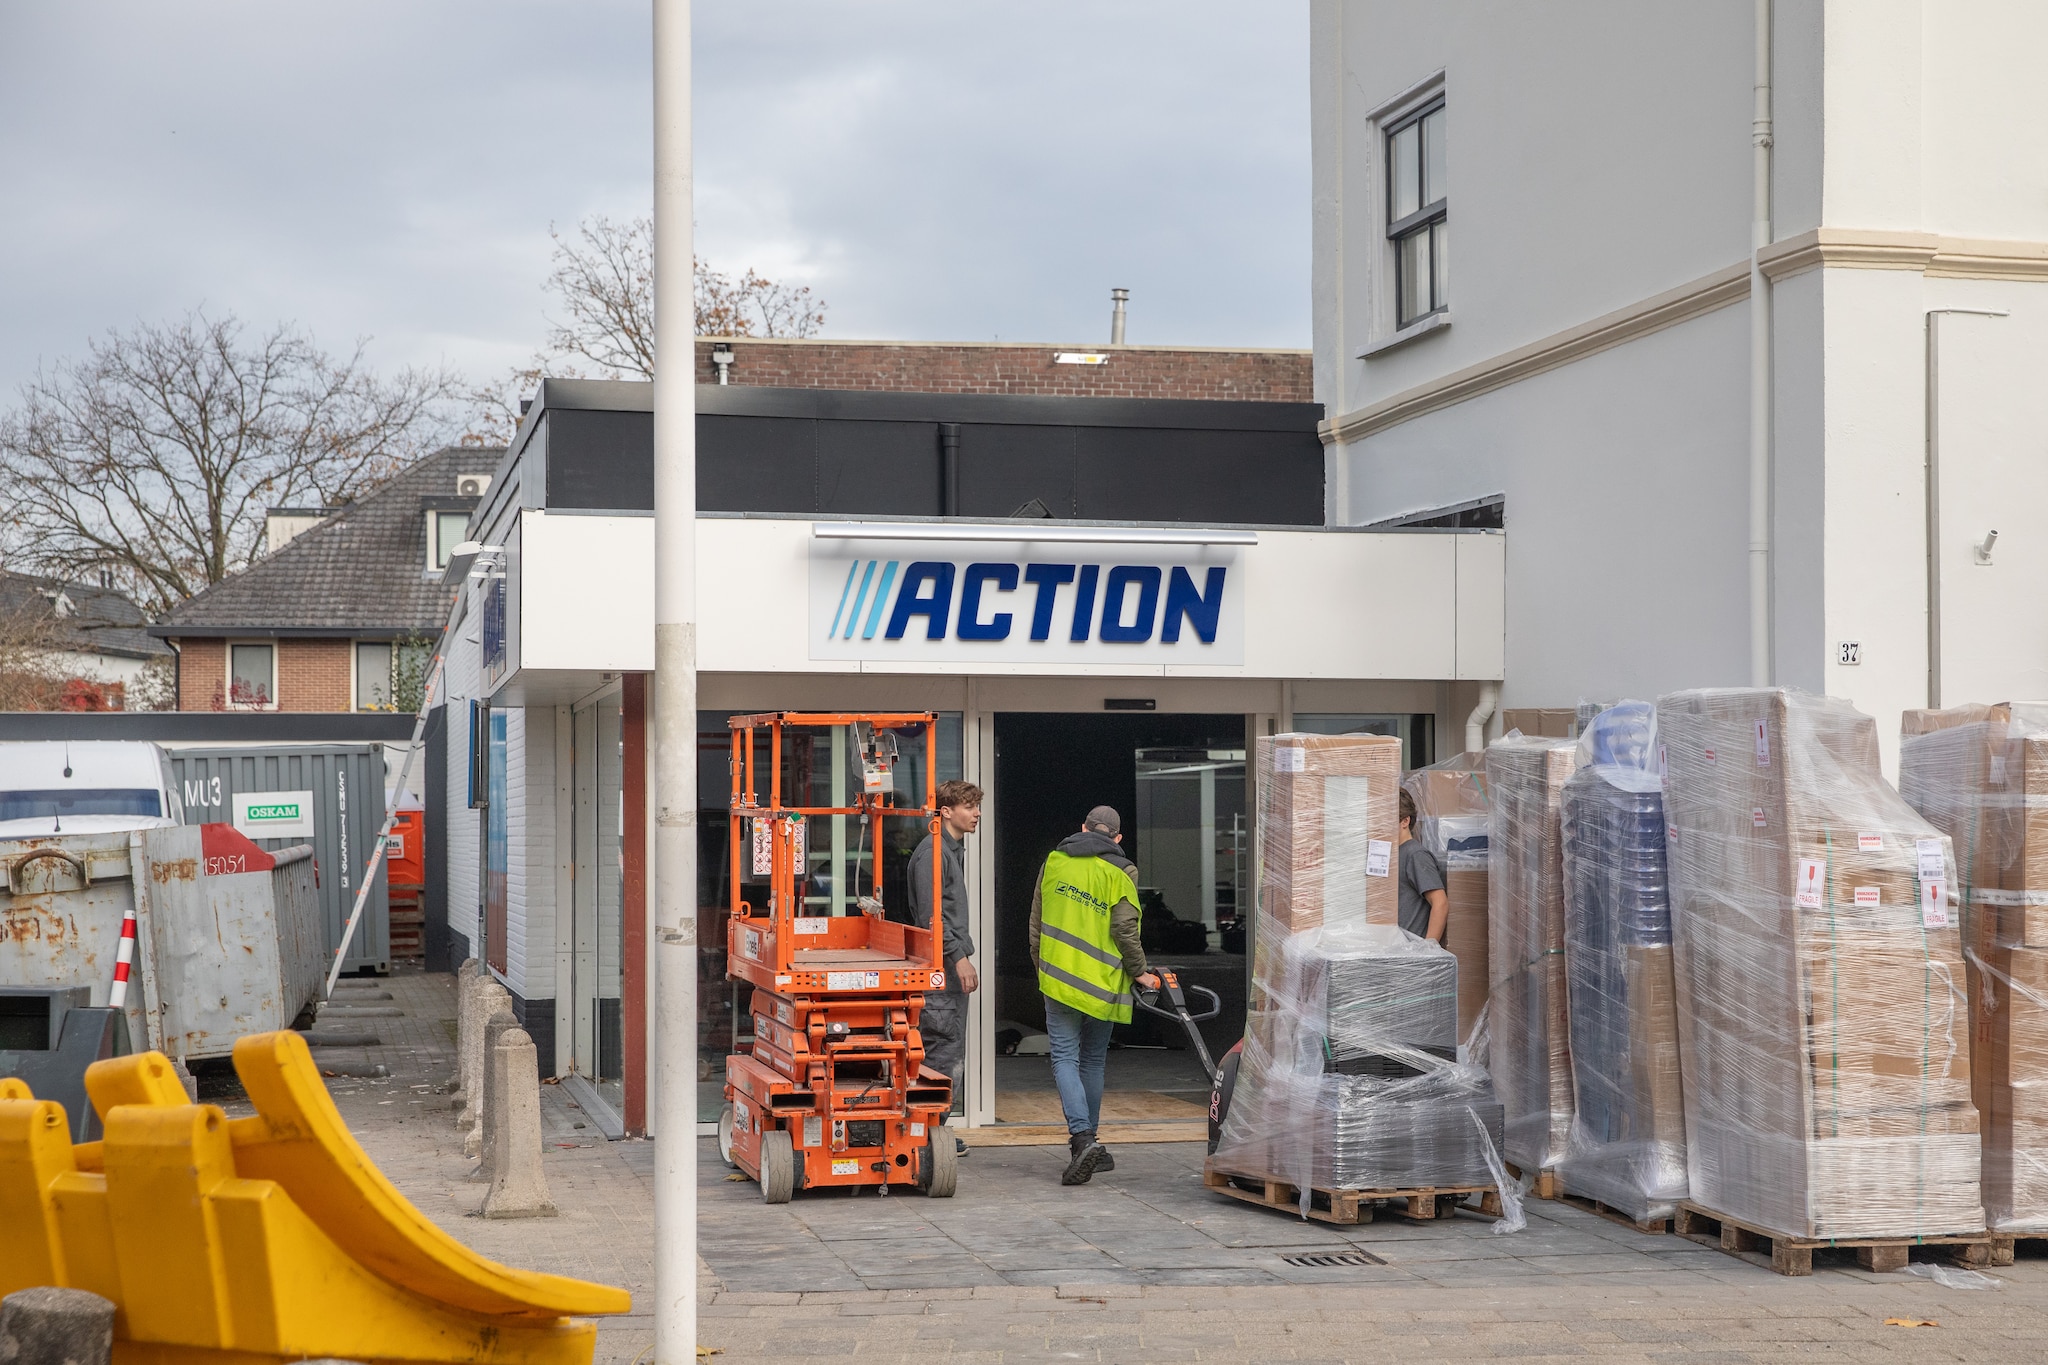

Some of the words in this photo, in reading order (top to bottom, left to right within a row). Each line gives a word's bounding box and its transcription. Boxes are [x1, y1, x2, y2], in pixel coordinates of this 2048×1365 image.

[884, 561, 1227, 643] ACTION
[1842, 643, 1858, 662] 37
[184, 776, 222, 807] MU3
[250, 806, 297, 818] OSKAM
[204, 854, 246, 876] 15051
[1065, 892, 1106, 916] LOGISTICS
[1068, 885, 1108, 910] RHENUS
[1799, 895, 1819, 904] FRAGILE
[1926, 914, 1945, 923] FRAGILE
[1214, 1069, 1225, 1089] 15
[1209, 1090, 1221, 1122] DC
